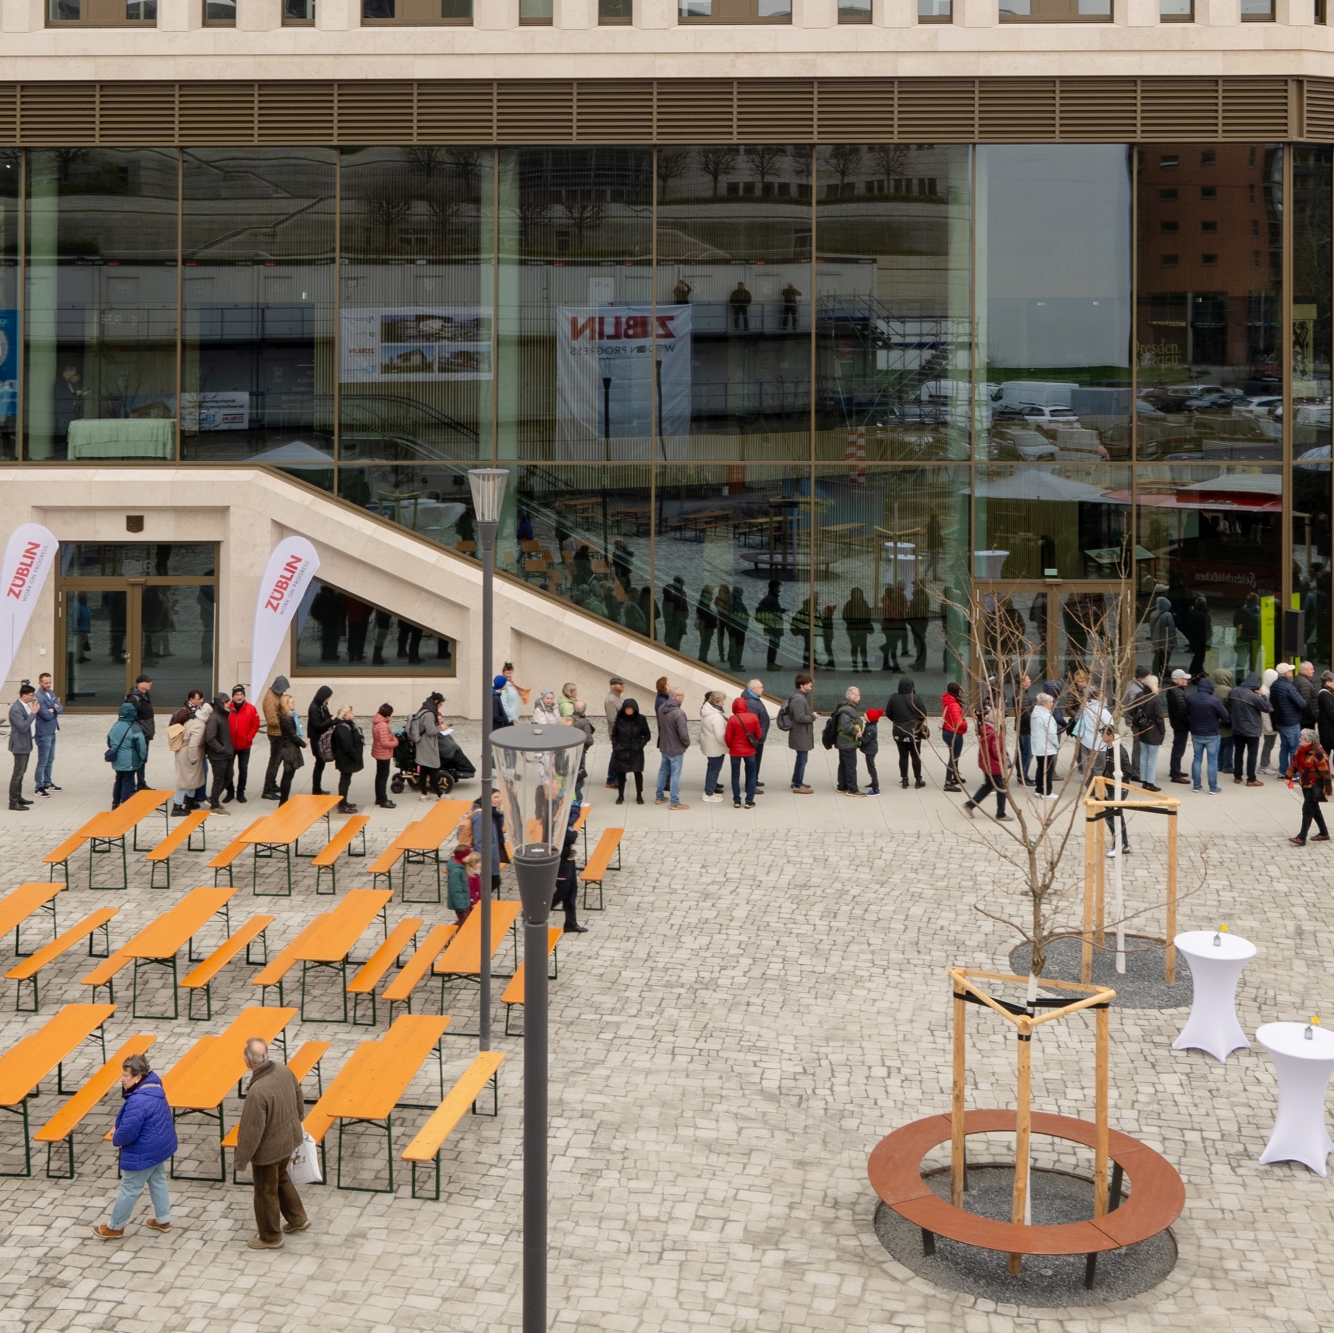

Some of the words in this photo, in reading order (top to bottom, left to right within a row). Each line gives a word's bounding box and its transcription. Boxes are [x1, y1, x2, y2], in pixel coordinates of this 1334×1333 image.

[6, 541, 41, 600] ZÜBLIN
[21, 585, 33, 602] WORK
[29, 574, 37, 584] ON
[33, 545, 49, 574] PROGRESS
[264, 554, 303, 613] ZÜBLIN
[279, 598, 291, 616] WORK
[287, 588, 296, 598] ON
[293, 560, 310, 588] PROGRESS
